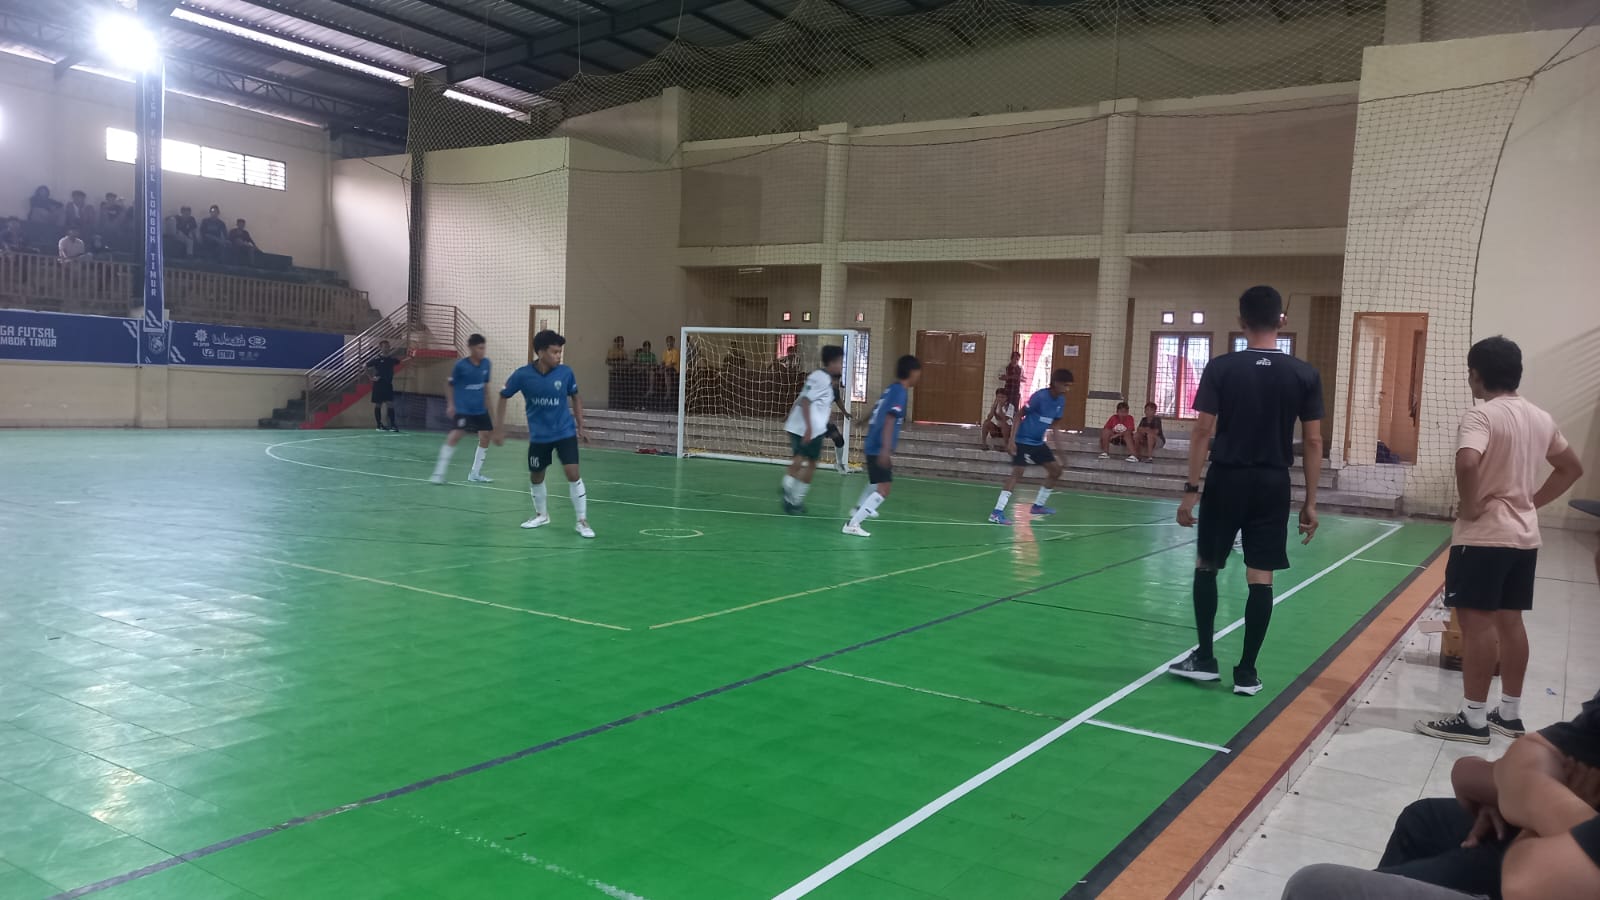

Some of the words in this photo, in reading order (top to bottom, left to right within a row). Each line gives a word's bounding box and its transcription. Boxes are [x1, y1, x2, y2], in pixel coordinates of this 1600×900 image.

[149, 191, 157, 244] LOMBOK
[149, 253, 157, 296] TIMUR
[17, 326, 57, 339] FUTSAL
[29, 337, 57, 348] TIMUR
